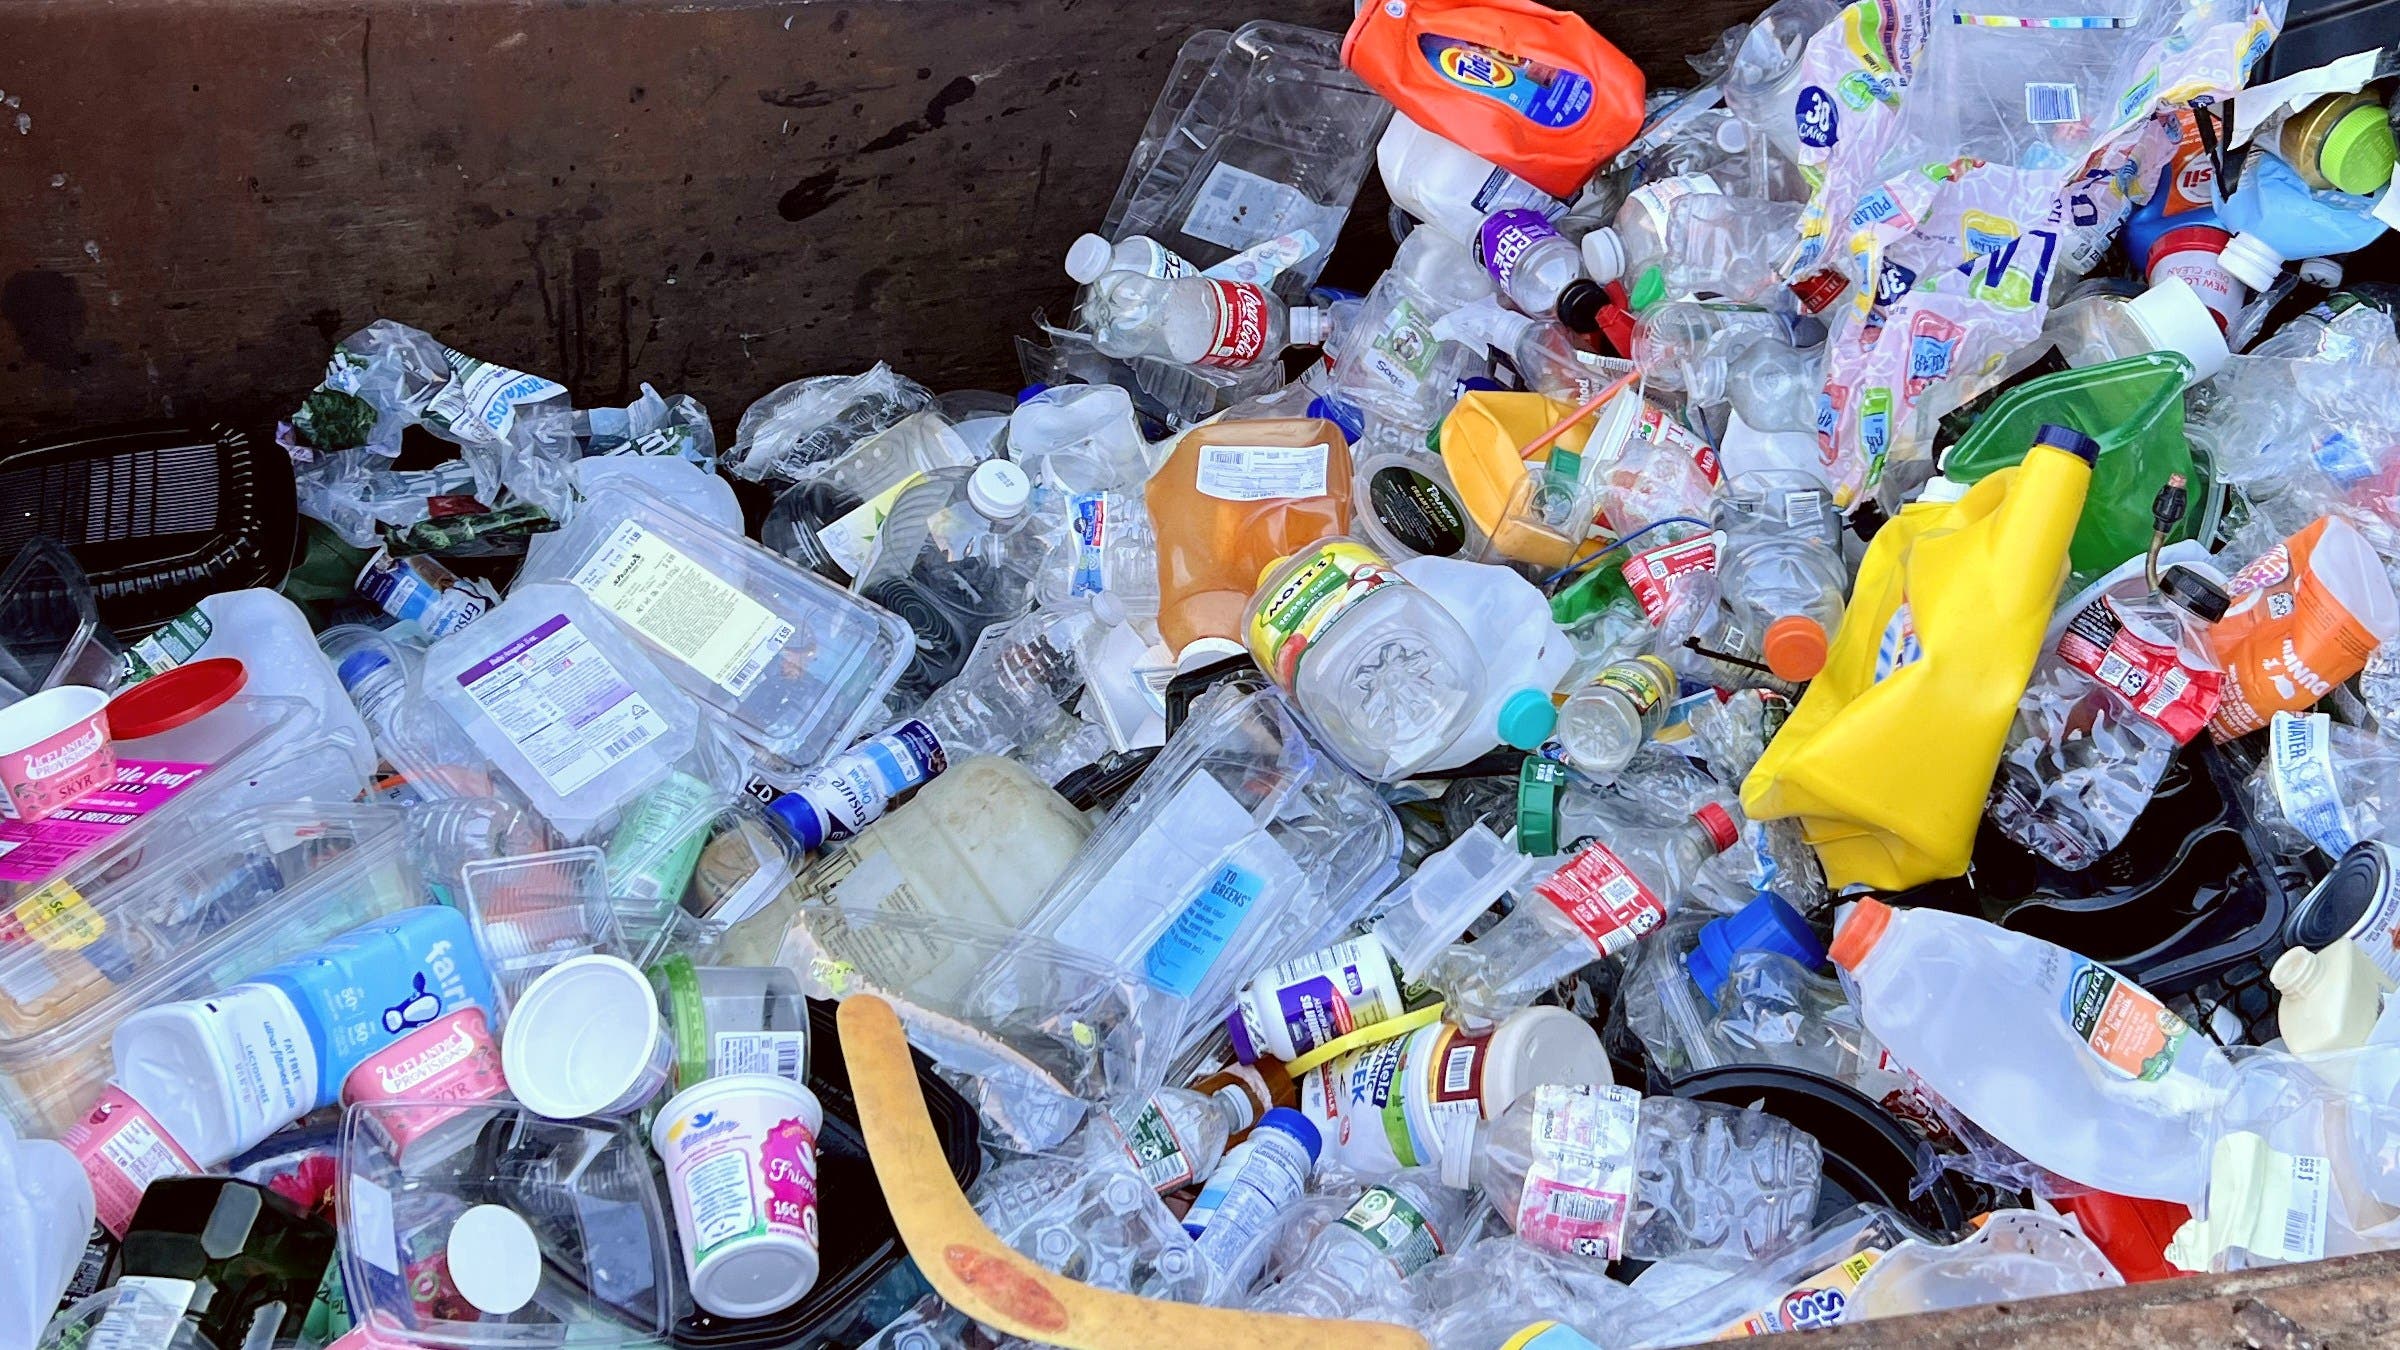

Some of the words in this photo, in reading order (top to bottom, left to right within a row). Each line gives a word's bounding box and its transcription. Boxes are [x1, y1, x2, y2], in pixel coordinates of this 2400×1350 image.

[1457, 53, 1492, 86] Tide
[2183, 169, 2213, 190] sil
[1851, 195, 1893, 227] POLAR
[1269, 559, 1328, 618] MOTT'S
[2289, 719, 2307, 762] WATER
[58, 774, 95, 800] SKYR
[831, 775, 868, 827] Ensure
[847, 767, 874, 806] Original
[1224, 868, 1238, 884] TO
[1210, 880, 1246, 908] GREENS
[2074, 964, 2107, 1032] GARELICK
